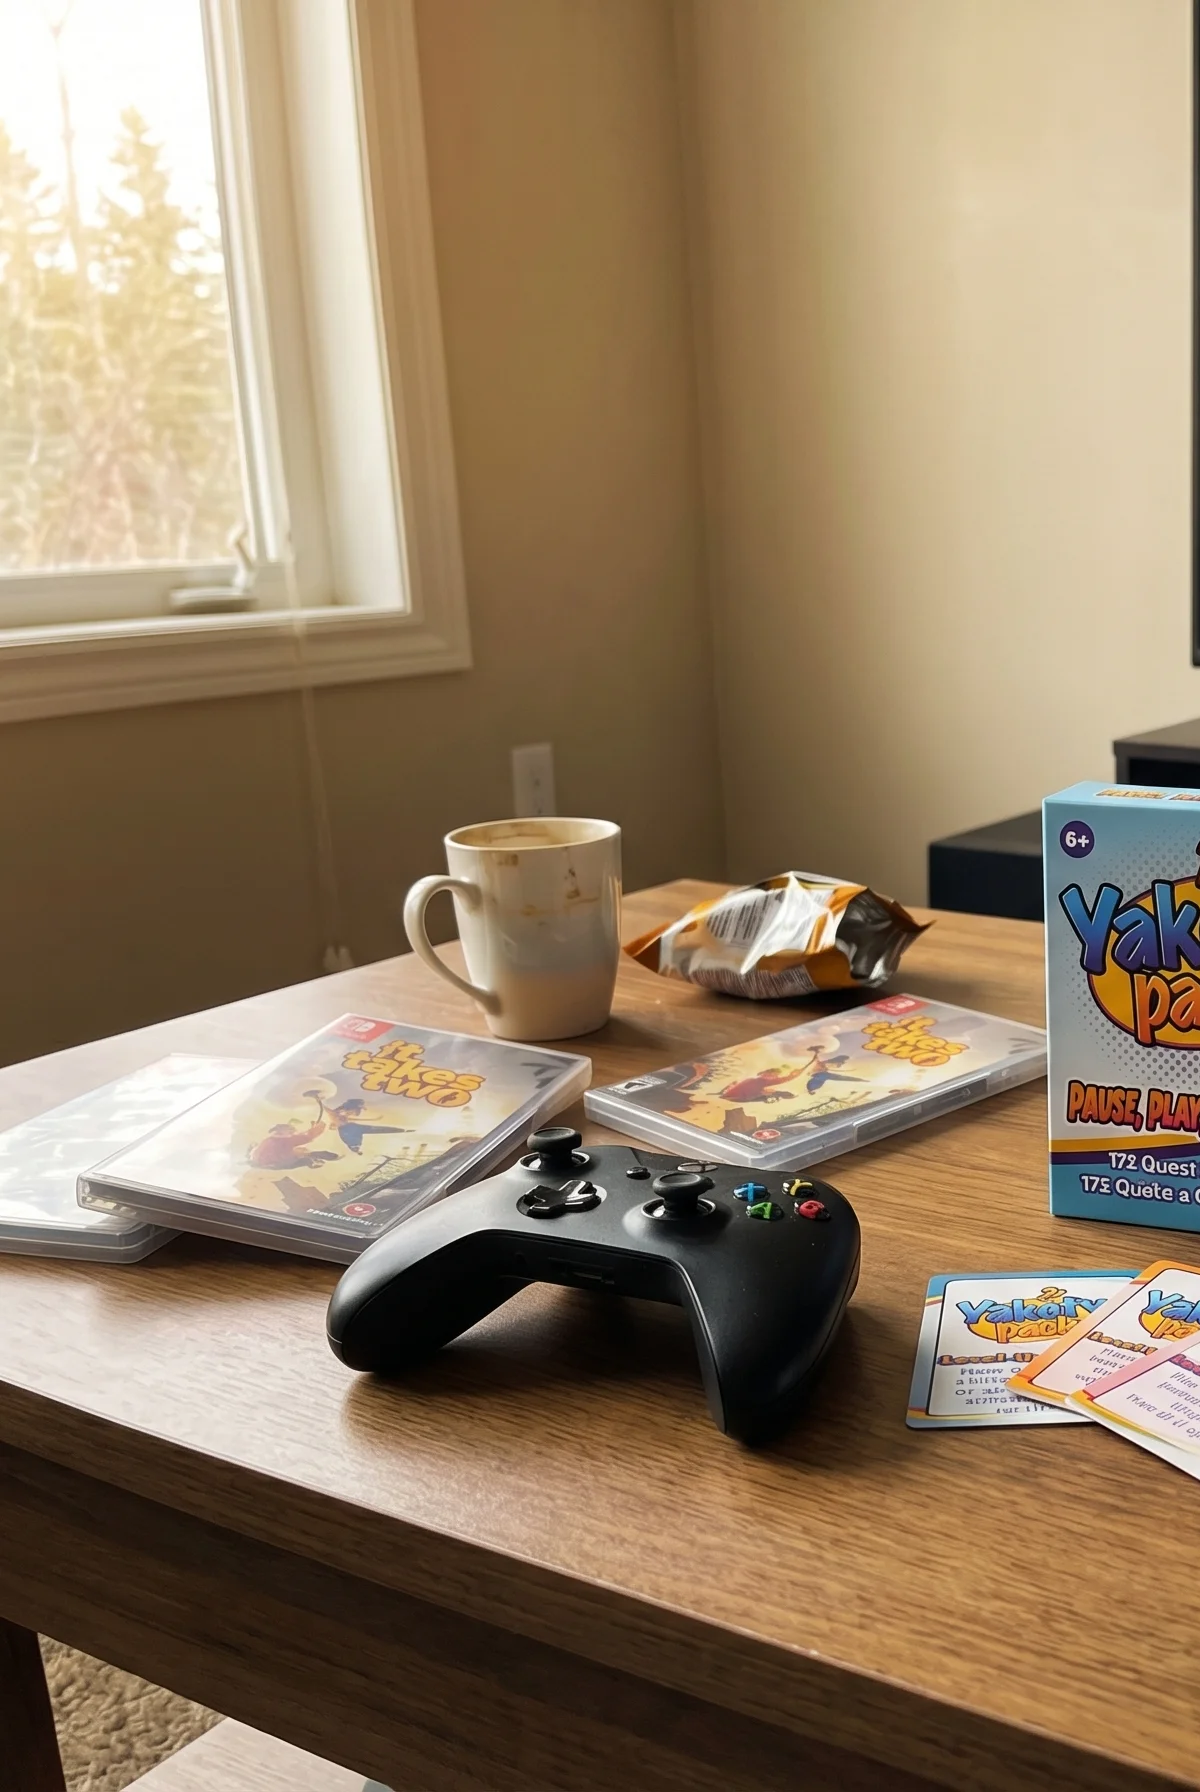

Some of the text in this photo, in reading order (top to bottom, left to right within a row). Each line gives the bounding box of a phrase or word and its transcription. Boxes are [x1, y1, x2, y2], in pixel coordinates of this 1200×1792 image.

[1064, 829, 1091, 850] 6+
[1066, 1080, 1144, 1132] PAUSE,
[1141, 1155, 1197, 1177] Quest
